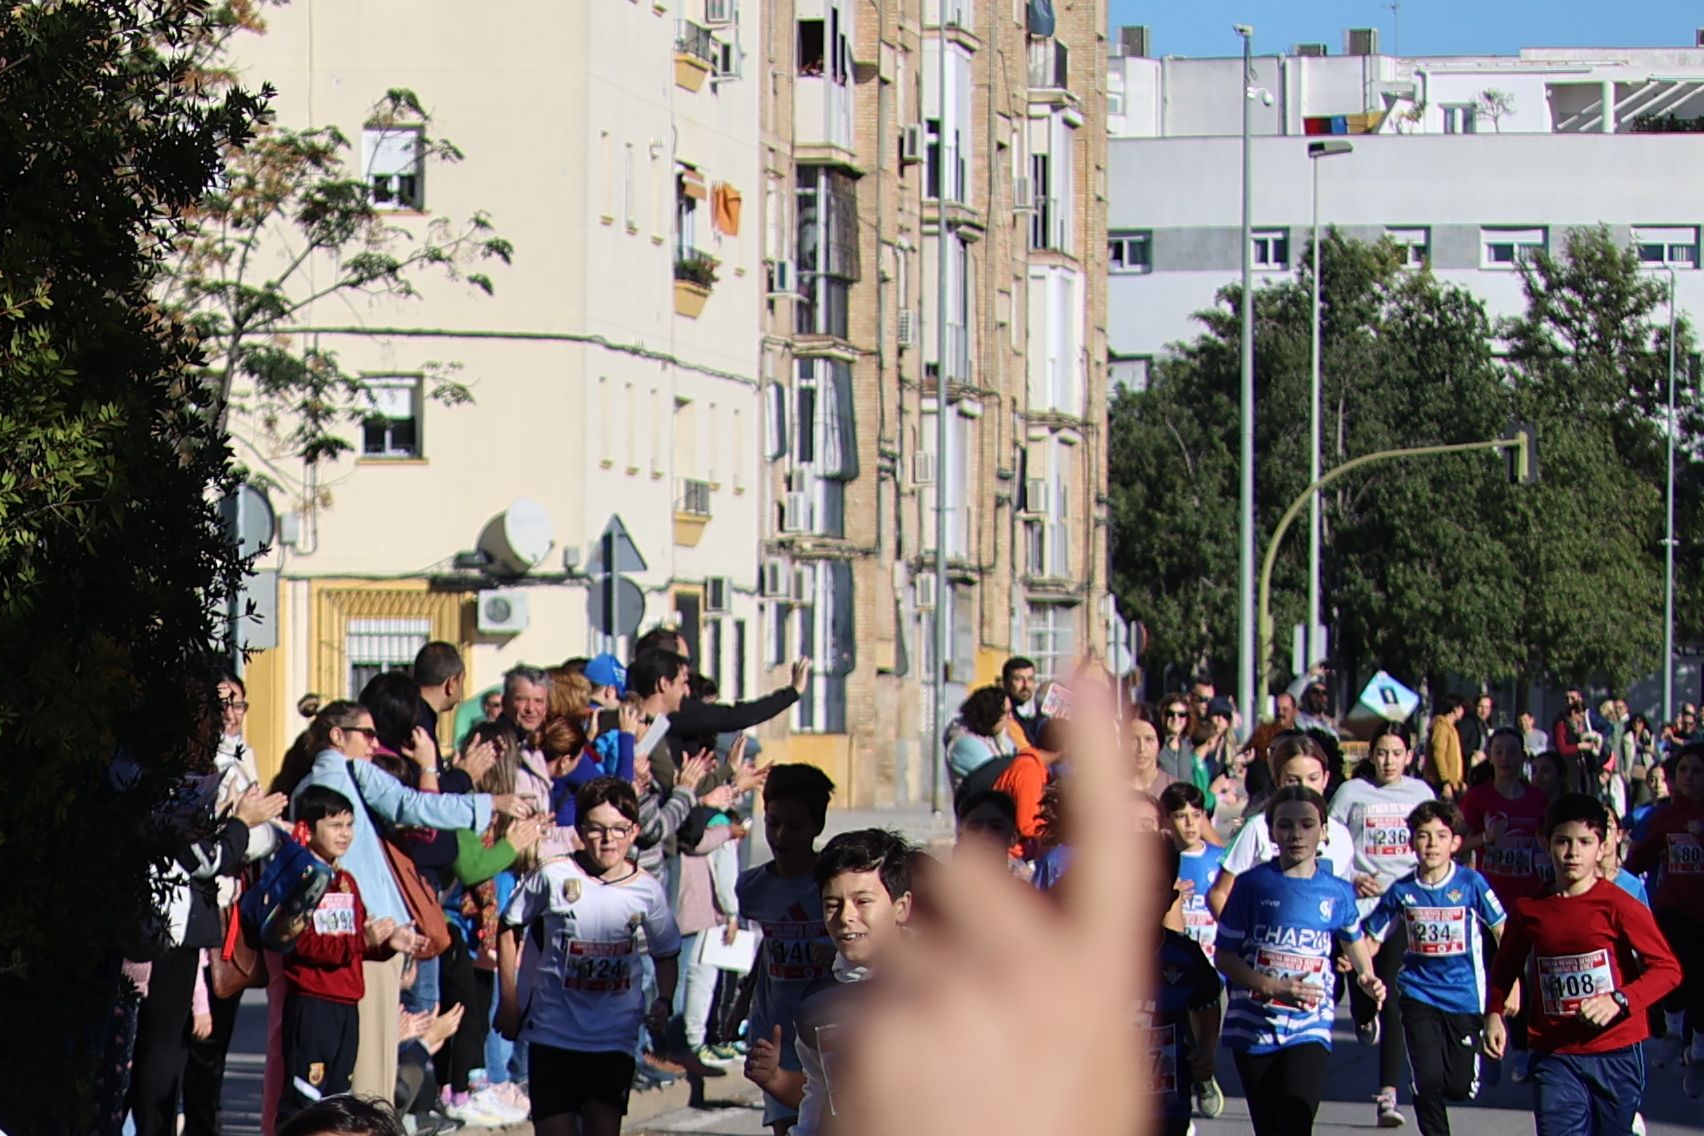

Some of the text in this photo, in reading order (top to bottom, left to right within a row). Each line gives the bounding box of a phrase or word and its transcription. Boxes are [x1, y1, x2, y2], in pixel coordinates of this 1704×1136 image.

[1377, 829, 1407, 844] 236
[1416, 923, 1450, 941] 234
[585, 958, 622, 978] 124
[1554, 973, 1594, 998] 108
